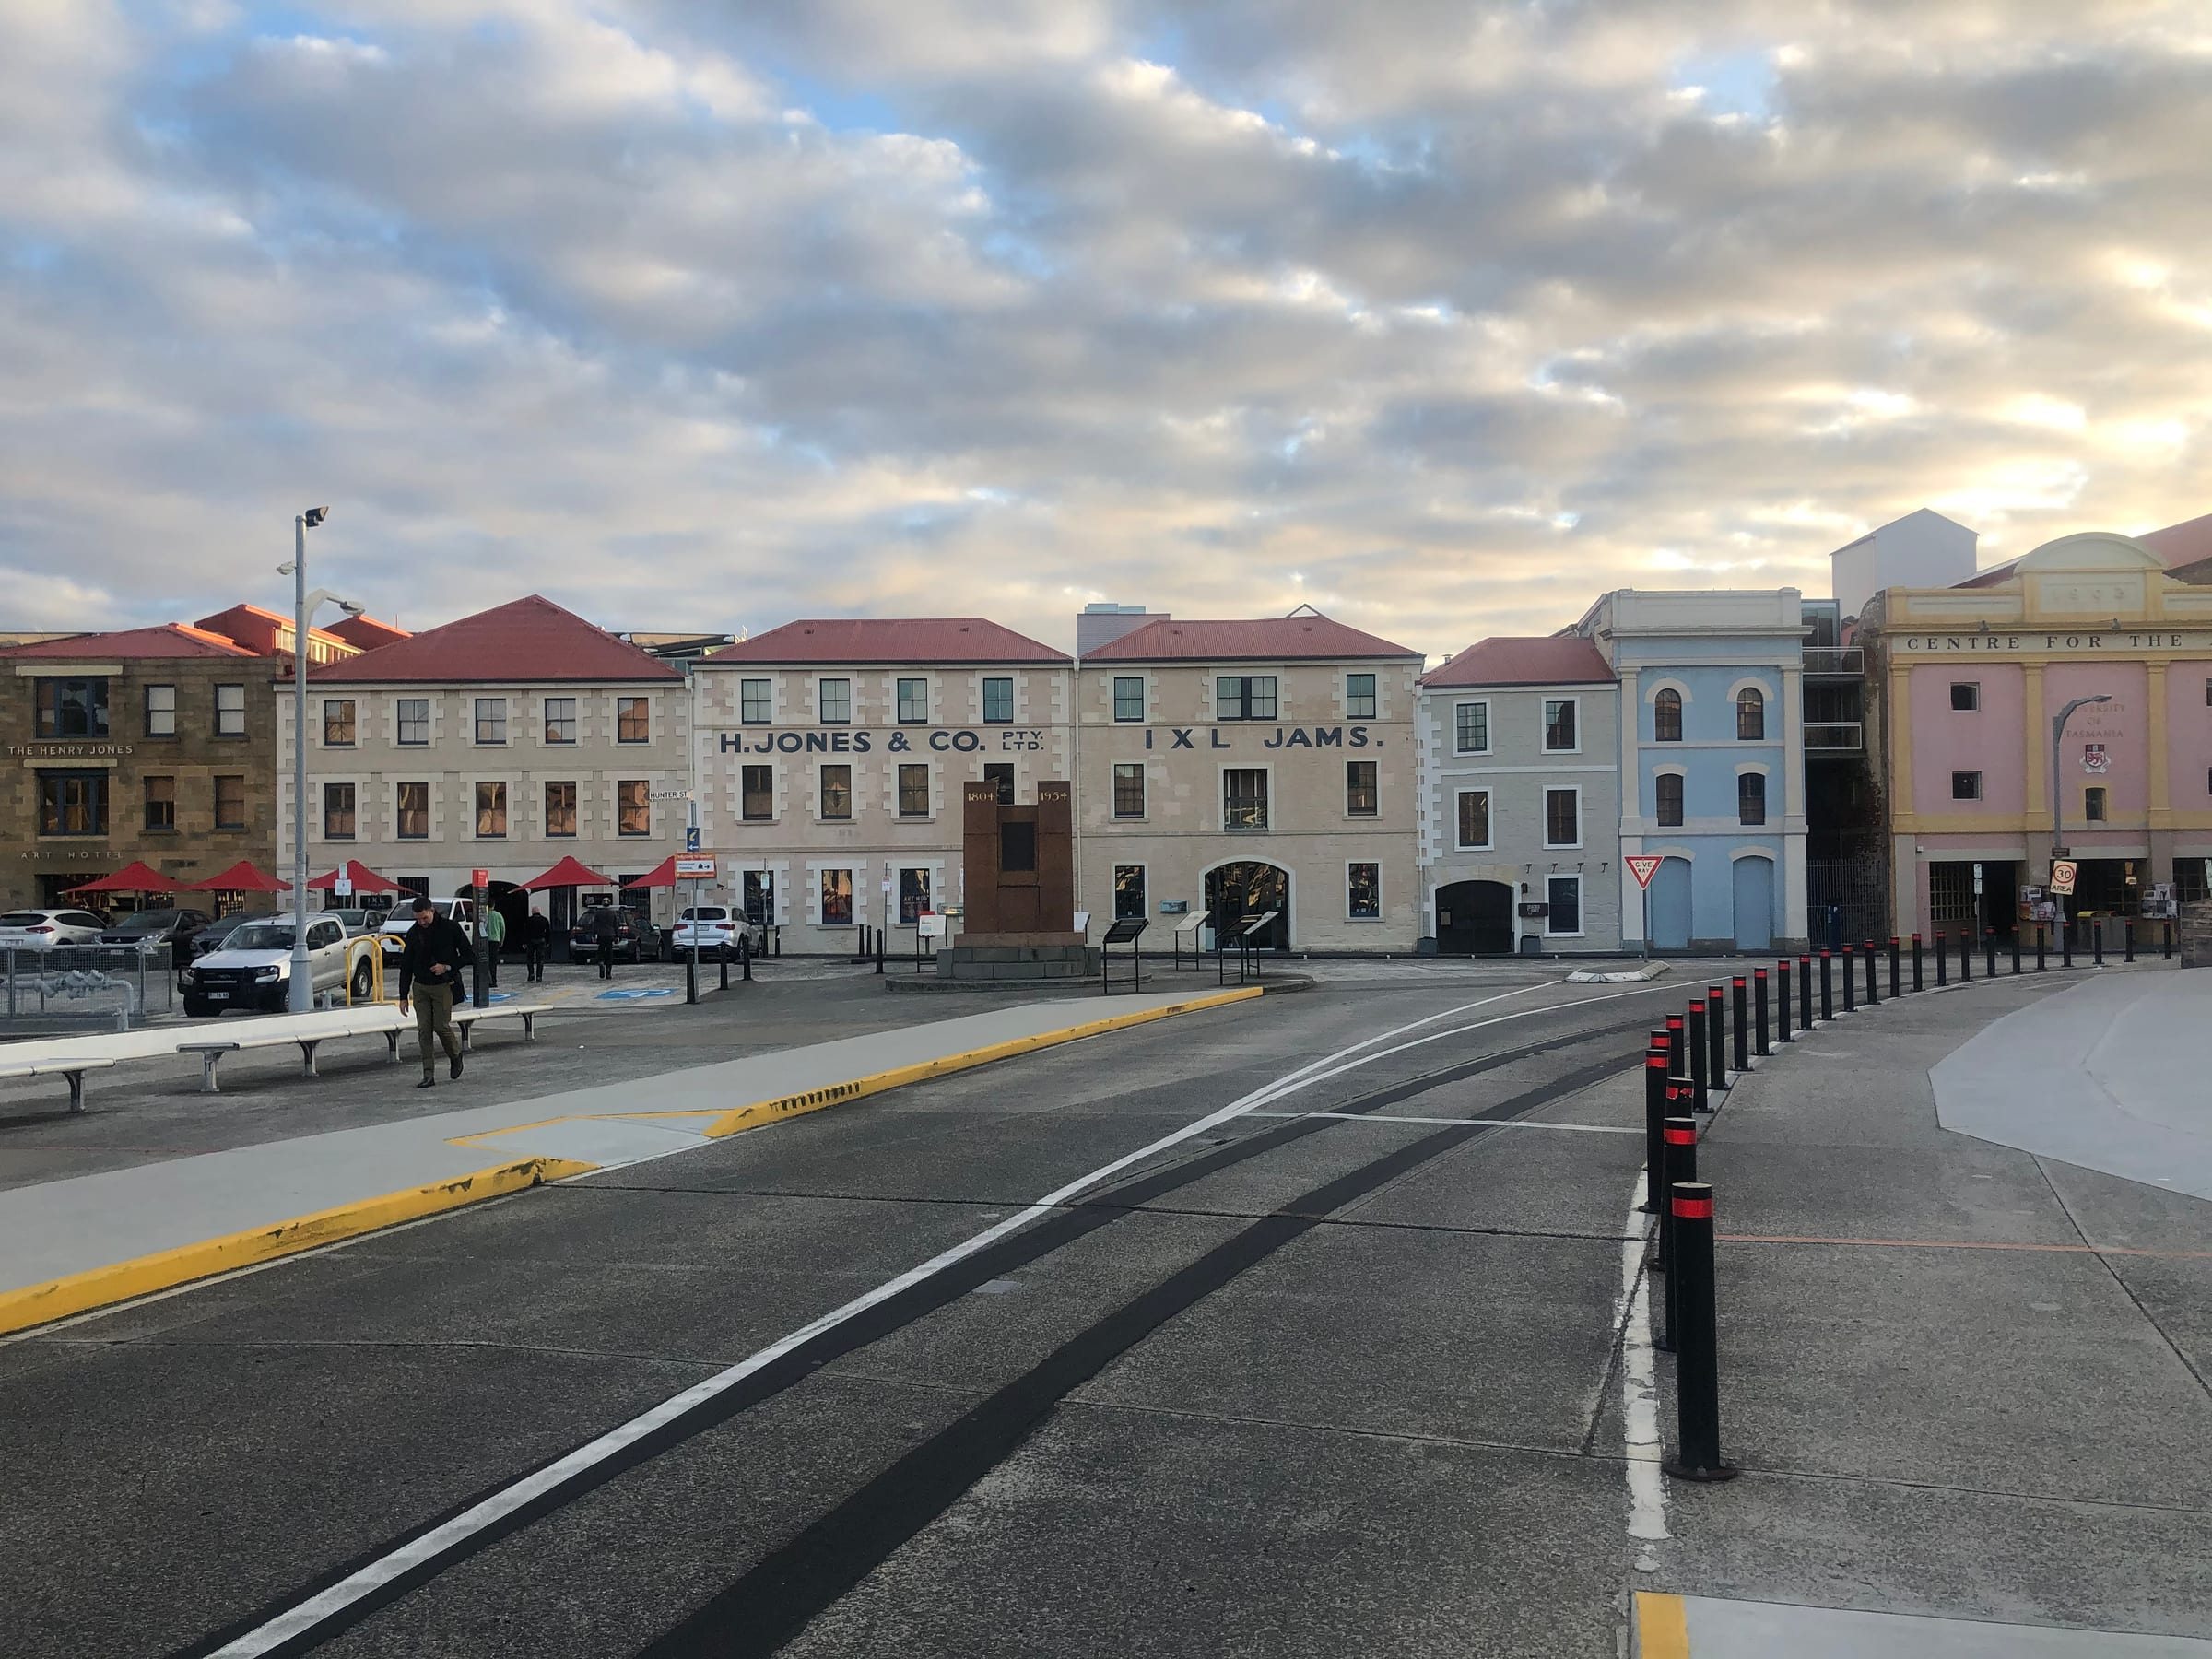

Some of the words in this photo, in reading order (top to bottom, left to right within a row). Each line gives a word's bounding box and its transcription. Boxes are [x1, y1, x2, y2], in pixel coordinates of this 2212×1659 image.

[1907, 636, 2020, 650] CENTRE
[2046, 635, 2102, 648] FOR
[2129, 634, 2183, 647] THE
[1002, 730, 1044, 741] PTY.
[1263, 726, 1383, 748] JAMS.
[2065, 730, 2124, 738] TASMANIA
[888, 731, 912, 753] &
[928, 730, 986, 753] CO.
[1002, 741, 1044, 751] LTD.
[7, 746, 34, 756] THE
[40, 746, 84, 756] HENRY
[89, 745, 134, 755] JONES
[650, 791, 677, 799] HUNTER
[679, 790, 688, 798] ST
[967, 792, 994, 802] 1804
[1040, 791, 1068, 801] 1954
[21, 851, 53, 860] ART
[68, 851, 123, 860] HOTEL
[2056, 869, 2072, 879] 30
[2052, 885, 2073, 893] AREA
